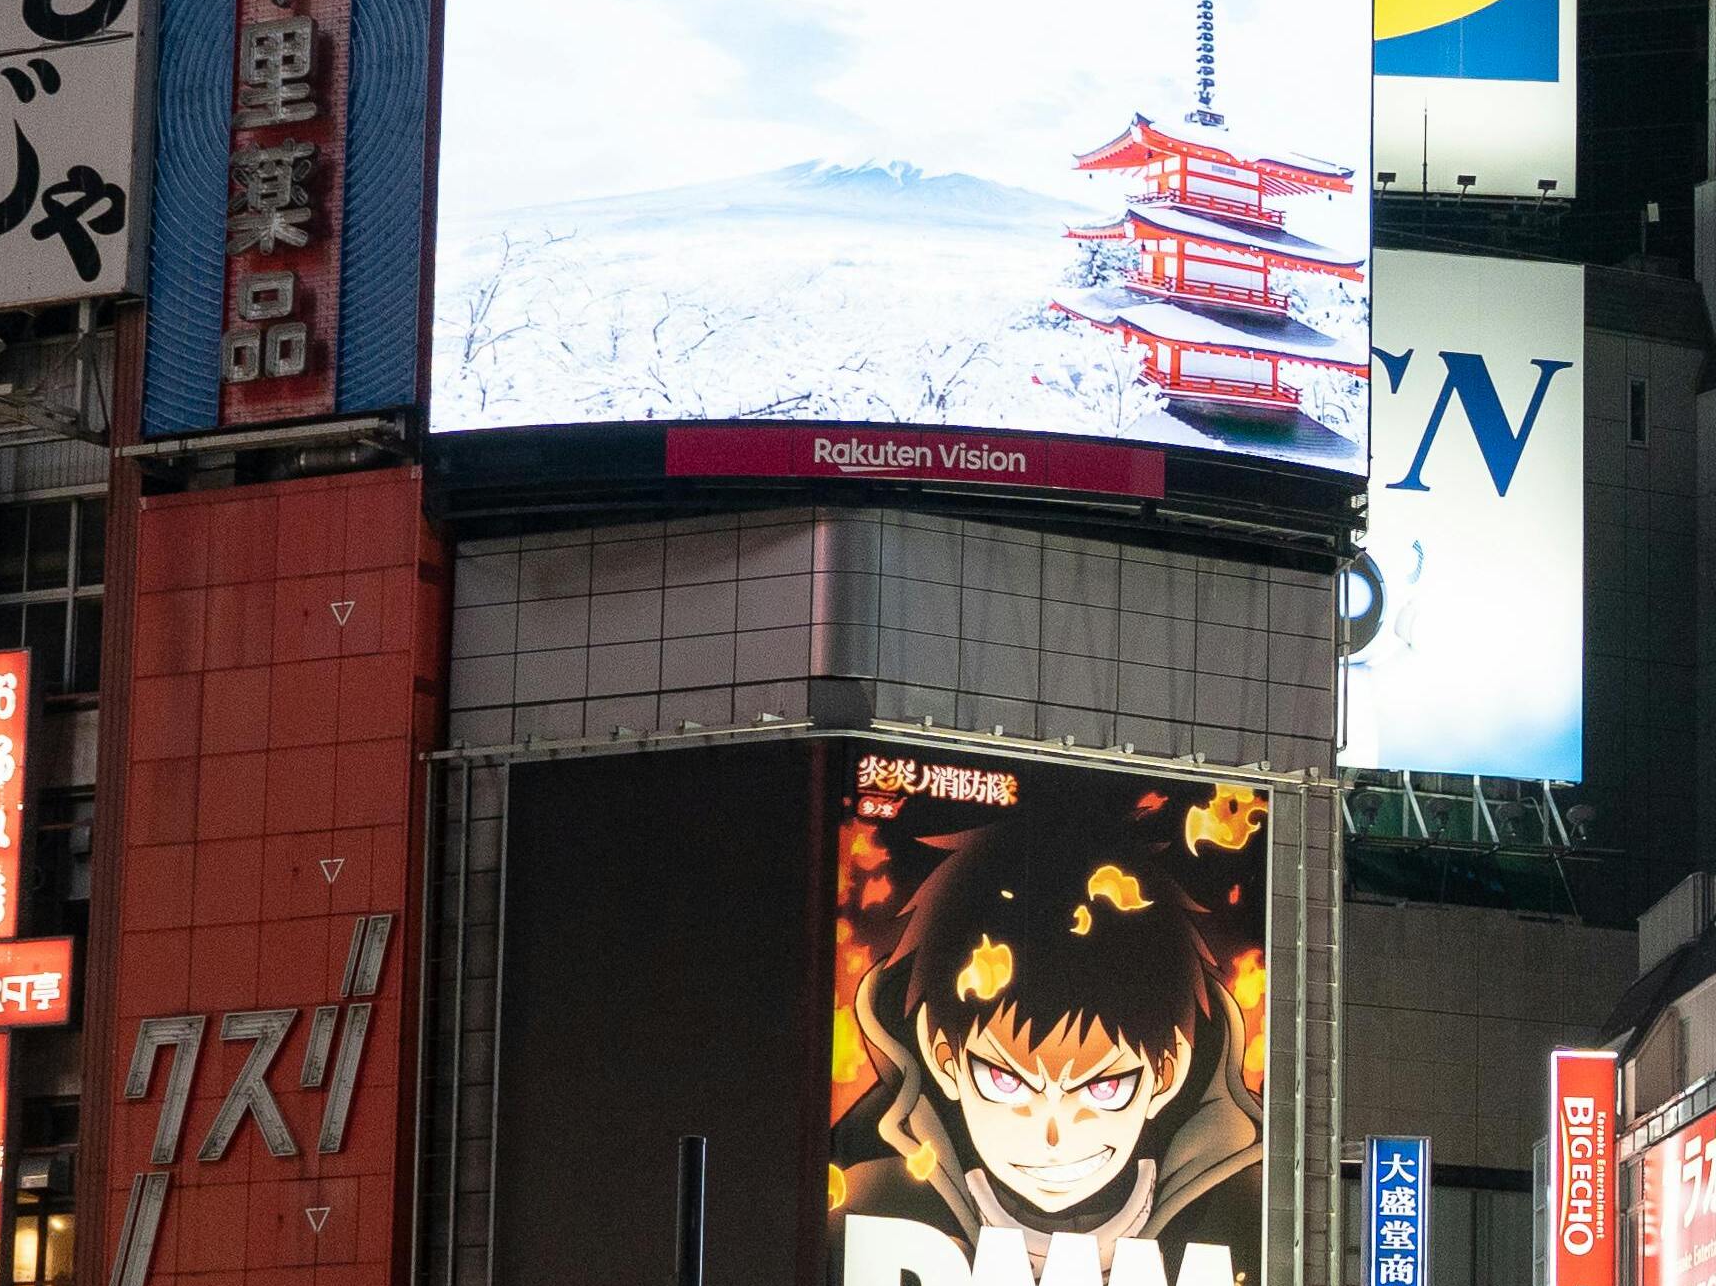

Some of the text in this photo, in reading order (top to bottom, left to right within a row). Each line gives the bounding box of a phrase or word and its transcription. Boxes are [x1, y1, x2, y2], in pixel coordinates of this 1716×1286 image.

[814, 437, 1026, 473] Rakuten Vision
[1562, 1096, 1596, 1256] BIG ECHO
